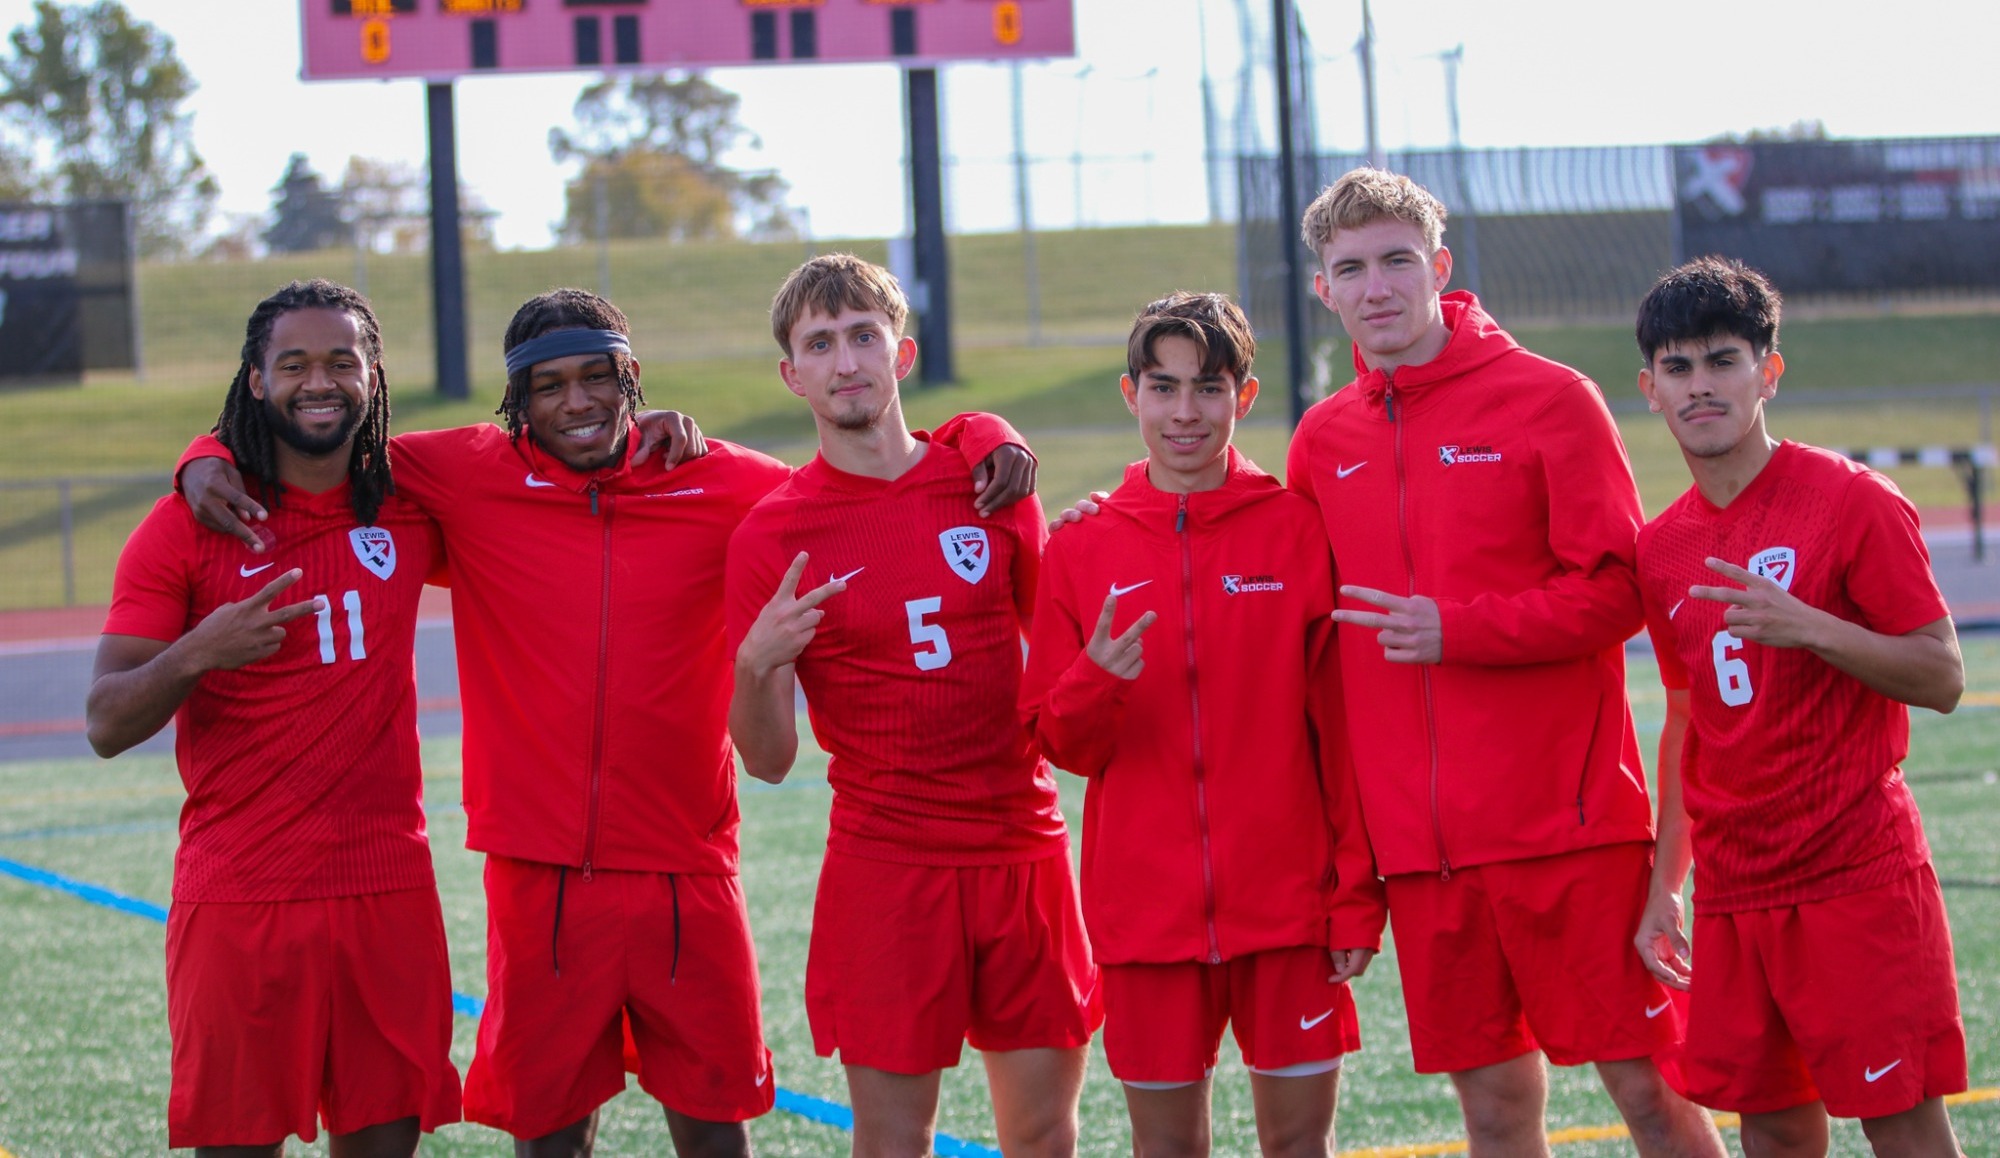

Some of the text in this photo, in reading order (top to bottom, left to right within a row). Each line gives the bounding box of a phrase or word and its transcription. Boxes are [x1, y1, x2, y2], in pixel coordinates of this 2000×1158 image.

[361, 19, 391, 63] 0
[1460, 446, 1492, 454] LEWIS
[1457, 453, 1502, 463] SOCCER
[358, 531, 386, 540] LEWIS
[950, 531, 980, 541] LEWIS
[1758, 552, 1787, 564] LEWIS
[1242, 575, 1275, 584] LEWIS
[1241, 582, 1283, 592] SOCCER
[313, 590, 366, 664] 11
[904, 596, 952, 671] 5
[1711, 630, 1754, 707] 6
